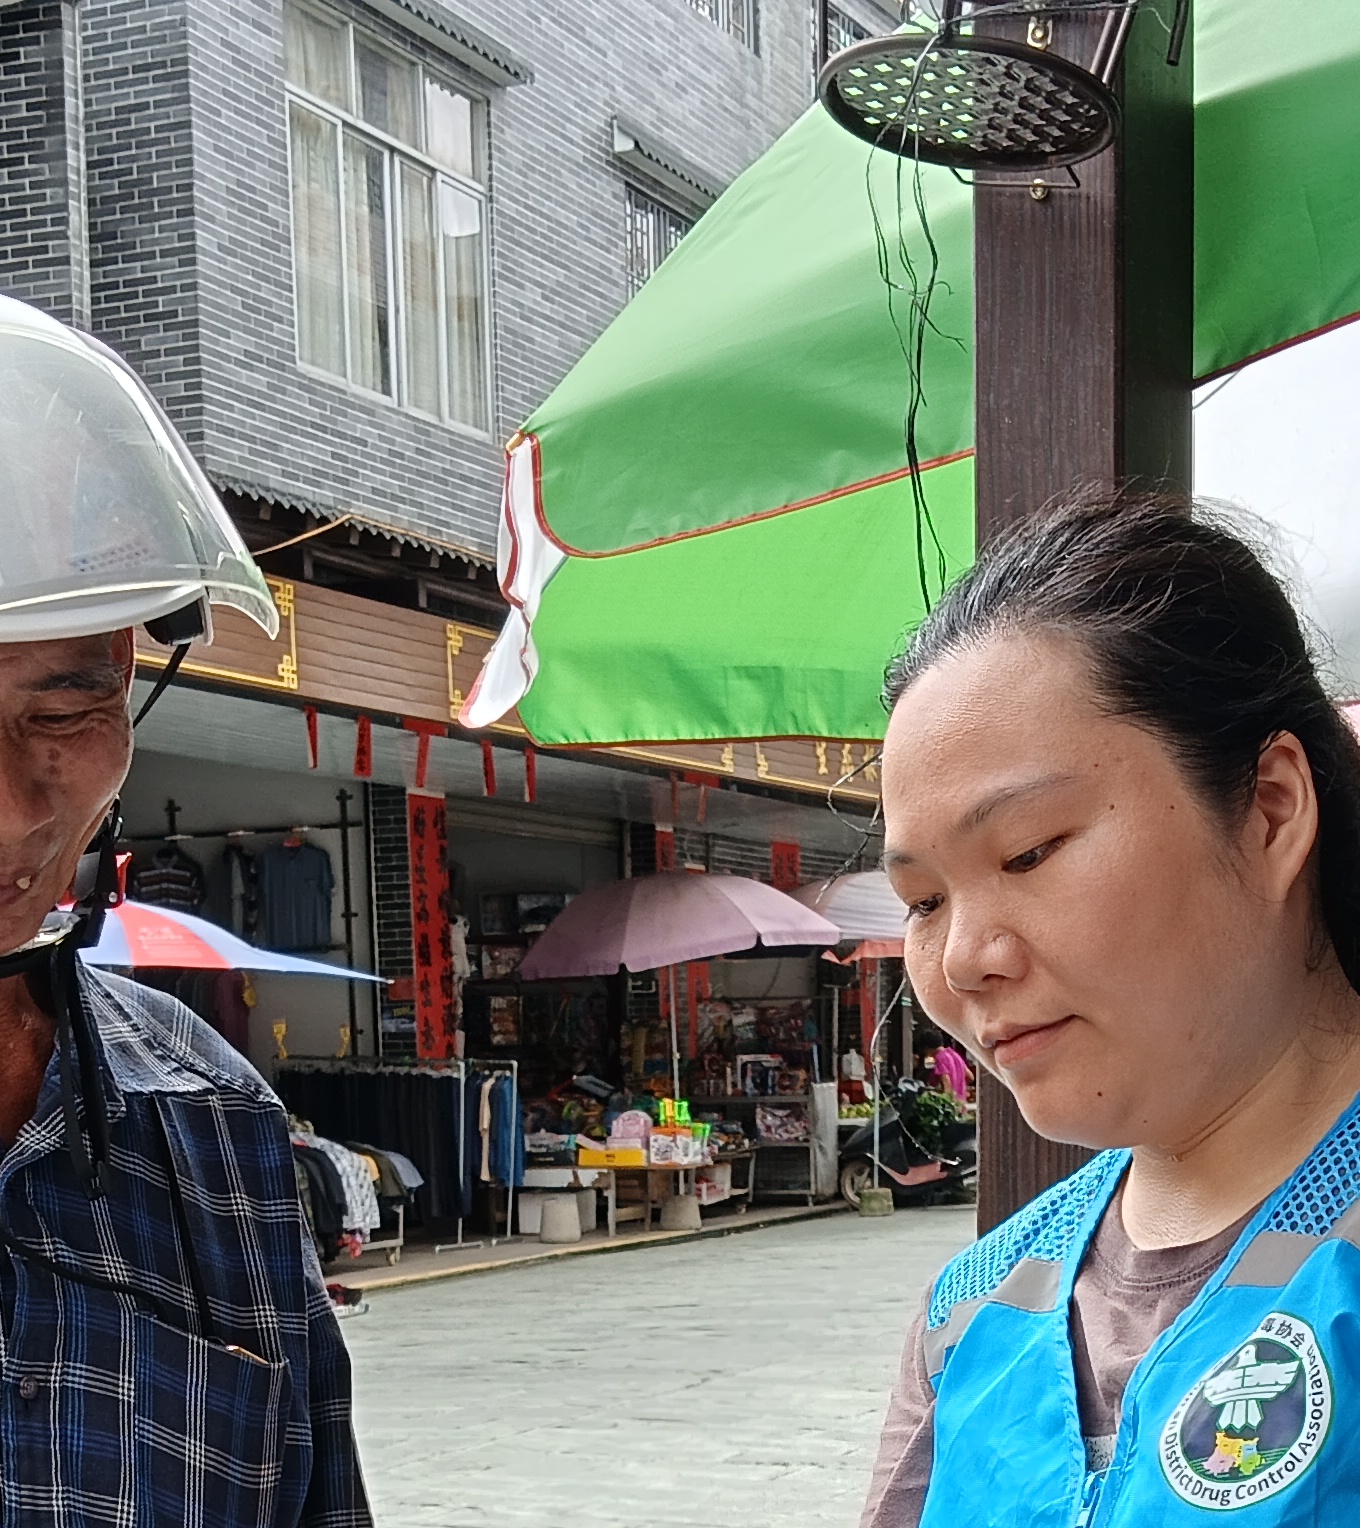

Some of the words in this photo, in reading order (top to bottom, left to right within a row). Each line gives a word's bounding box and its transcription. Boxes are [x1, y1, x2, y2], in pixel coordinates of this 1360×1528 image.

[1164, 1434, 1194, 1492] District
[1191, 1480, 1232, 1506] Drug
[1236, 1452, 1303, 1501] Control
